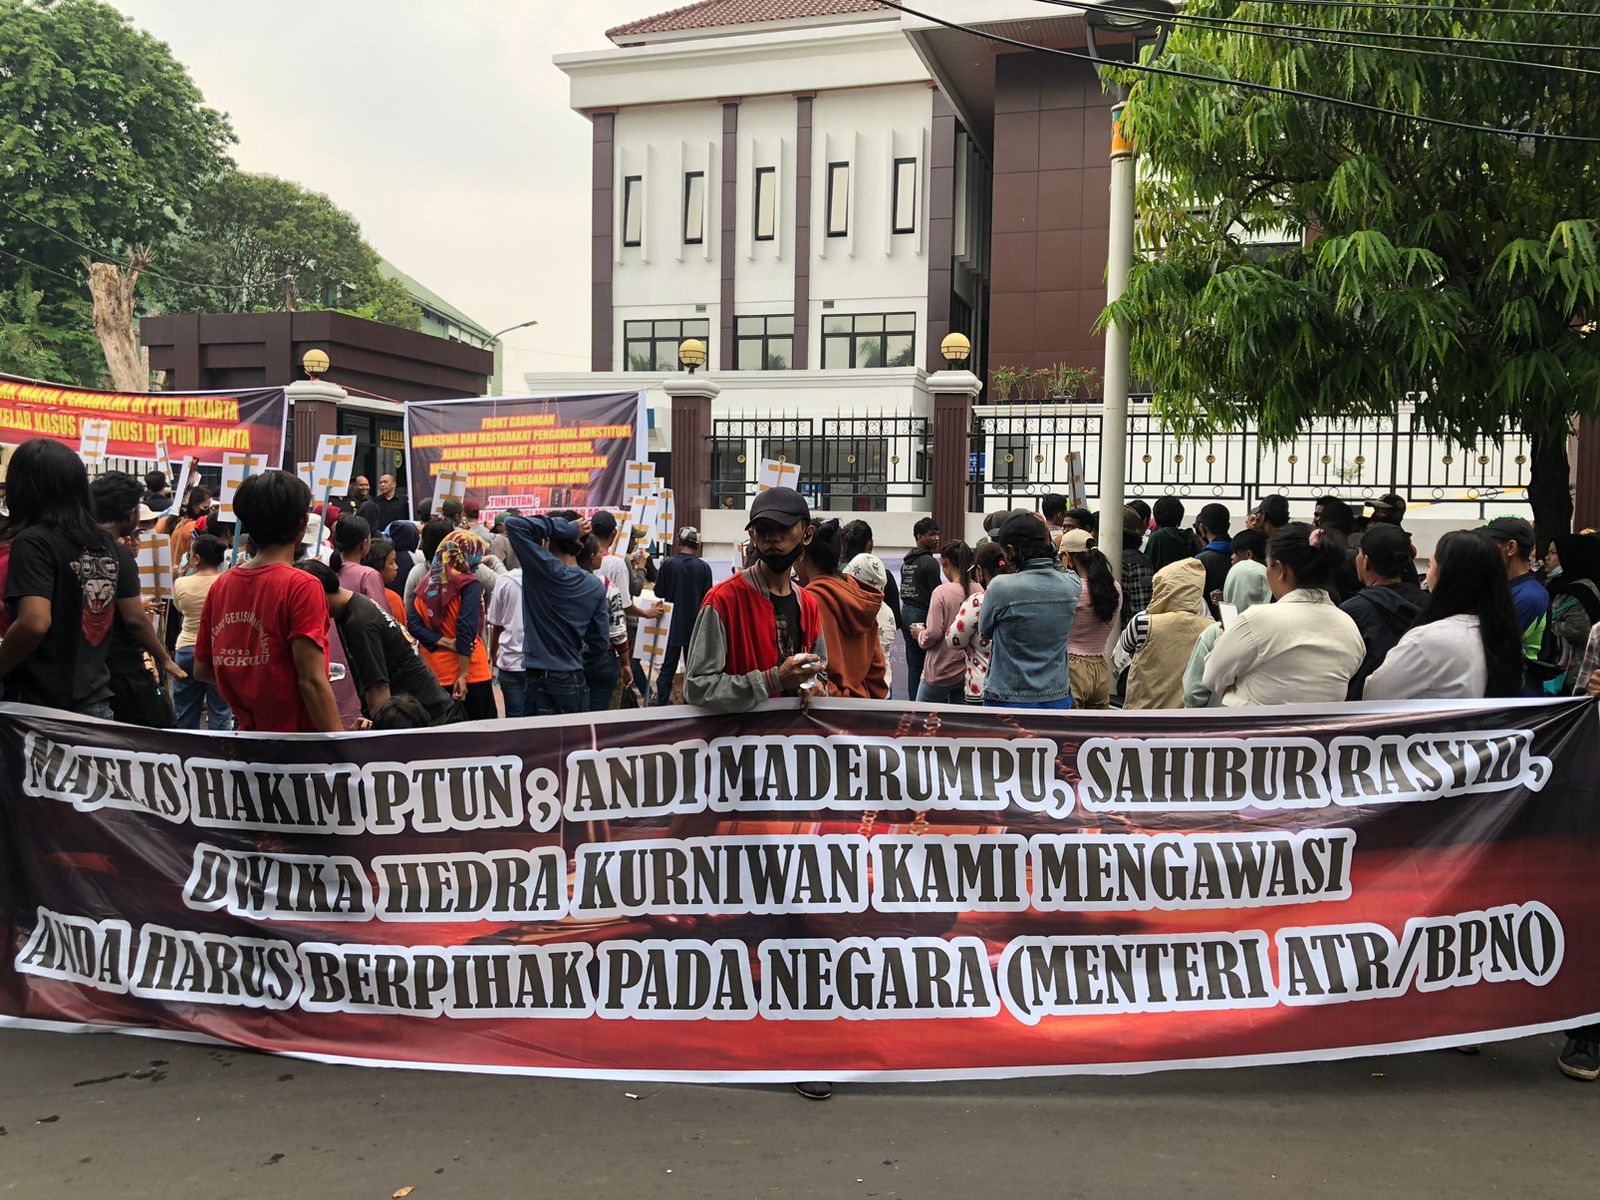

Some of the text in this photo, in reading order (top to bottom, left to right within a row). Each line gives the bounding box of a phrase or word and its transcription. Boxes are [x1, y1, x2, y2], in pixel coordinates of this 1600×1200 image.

[18, 386, 61, 406] MAFIA
[60, 391, 132, 412] PERADILAN
[131, 397, 146, 414] DI
[147, 398, 181, 417] PTUN
[184, 399, 239, 421] JAKARTA
[34, 411, 77, 436] KASUS
[146, 422, 160, 443] DI
[162, 424, 196, 447] PTUN
[198, 427, 251, 450] JAKARTA
[478, 430, 532, 446] MASYARAKAT
[533, 427, 577, 442] PENGAWAL
[458, 459, 512, 474] MASYARAKAT
[512, 458, 532, 471] ANTI
[533, 457, 559, 470] MAFIA
[560, 454, 609, 469] PERADILAN
[474, 444, 528, 460] MASYARAKAT
[530, 442, 558, 456] PEDULI
[476, 473, 507, 487] KOMITE
[508, 472, 556, 486] PENEGAKAN
[557, 471, 590, 484] HUKUM
[490, 495, 534, 508] TUNTUTAN
[30, 736, 182, 816] MAJELIS
[191, 765, 366, 828] HAKIM
[371, 763, 516, 826] PTUN
[572, 747, 702, 813] ANDI
[717, 743, 1067, 811] MADERUMPU,
[1085, 745, 1321, 803] SAHIBUR
[1336, 735, 1544, 798] RASYID,
[189, 836, 1349, 914] DWIKA HEDRA KURNIWAN KAMI MENGAWASI
[22, 914, 123, 986] ANDA
[136, 931, 296, 1002] HARUS
[304, 949, 584, 1011] BERPIHAK
[605, 947, 749, 1011] PADA
[767, 946, 991, 1012] NEGARA
[1004, 937, 1270, 1016] (MENTERI
